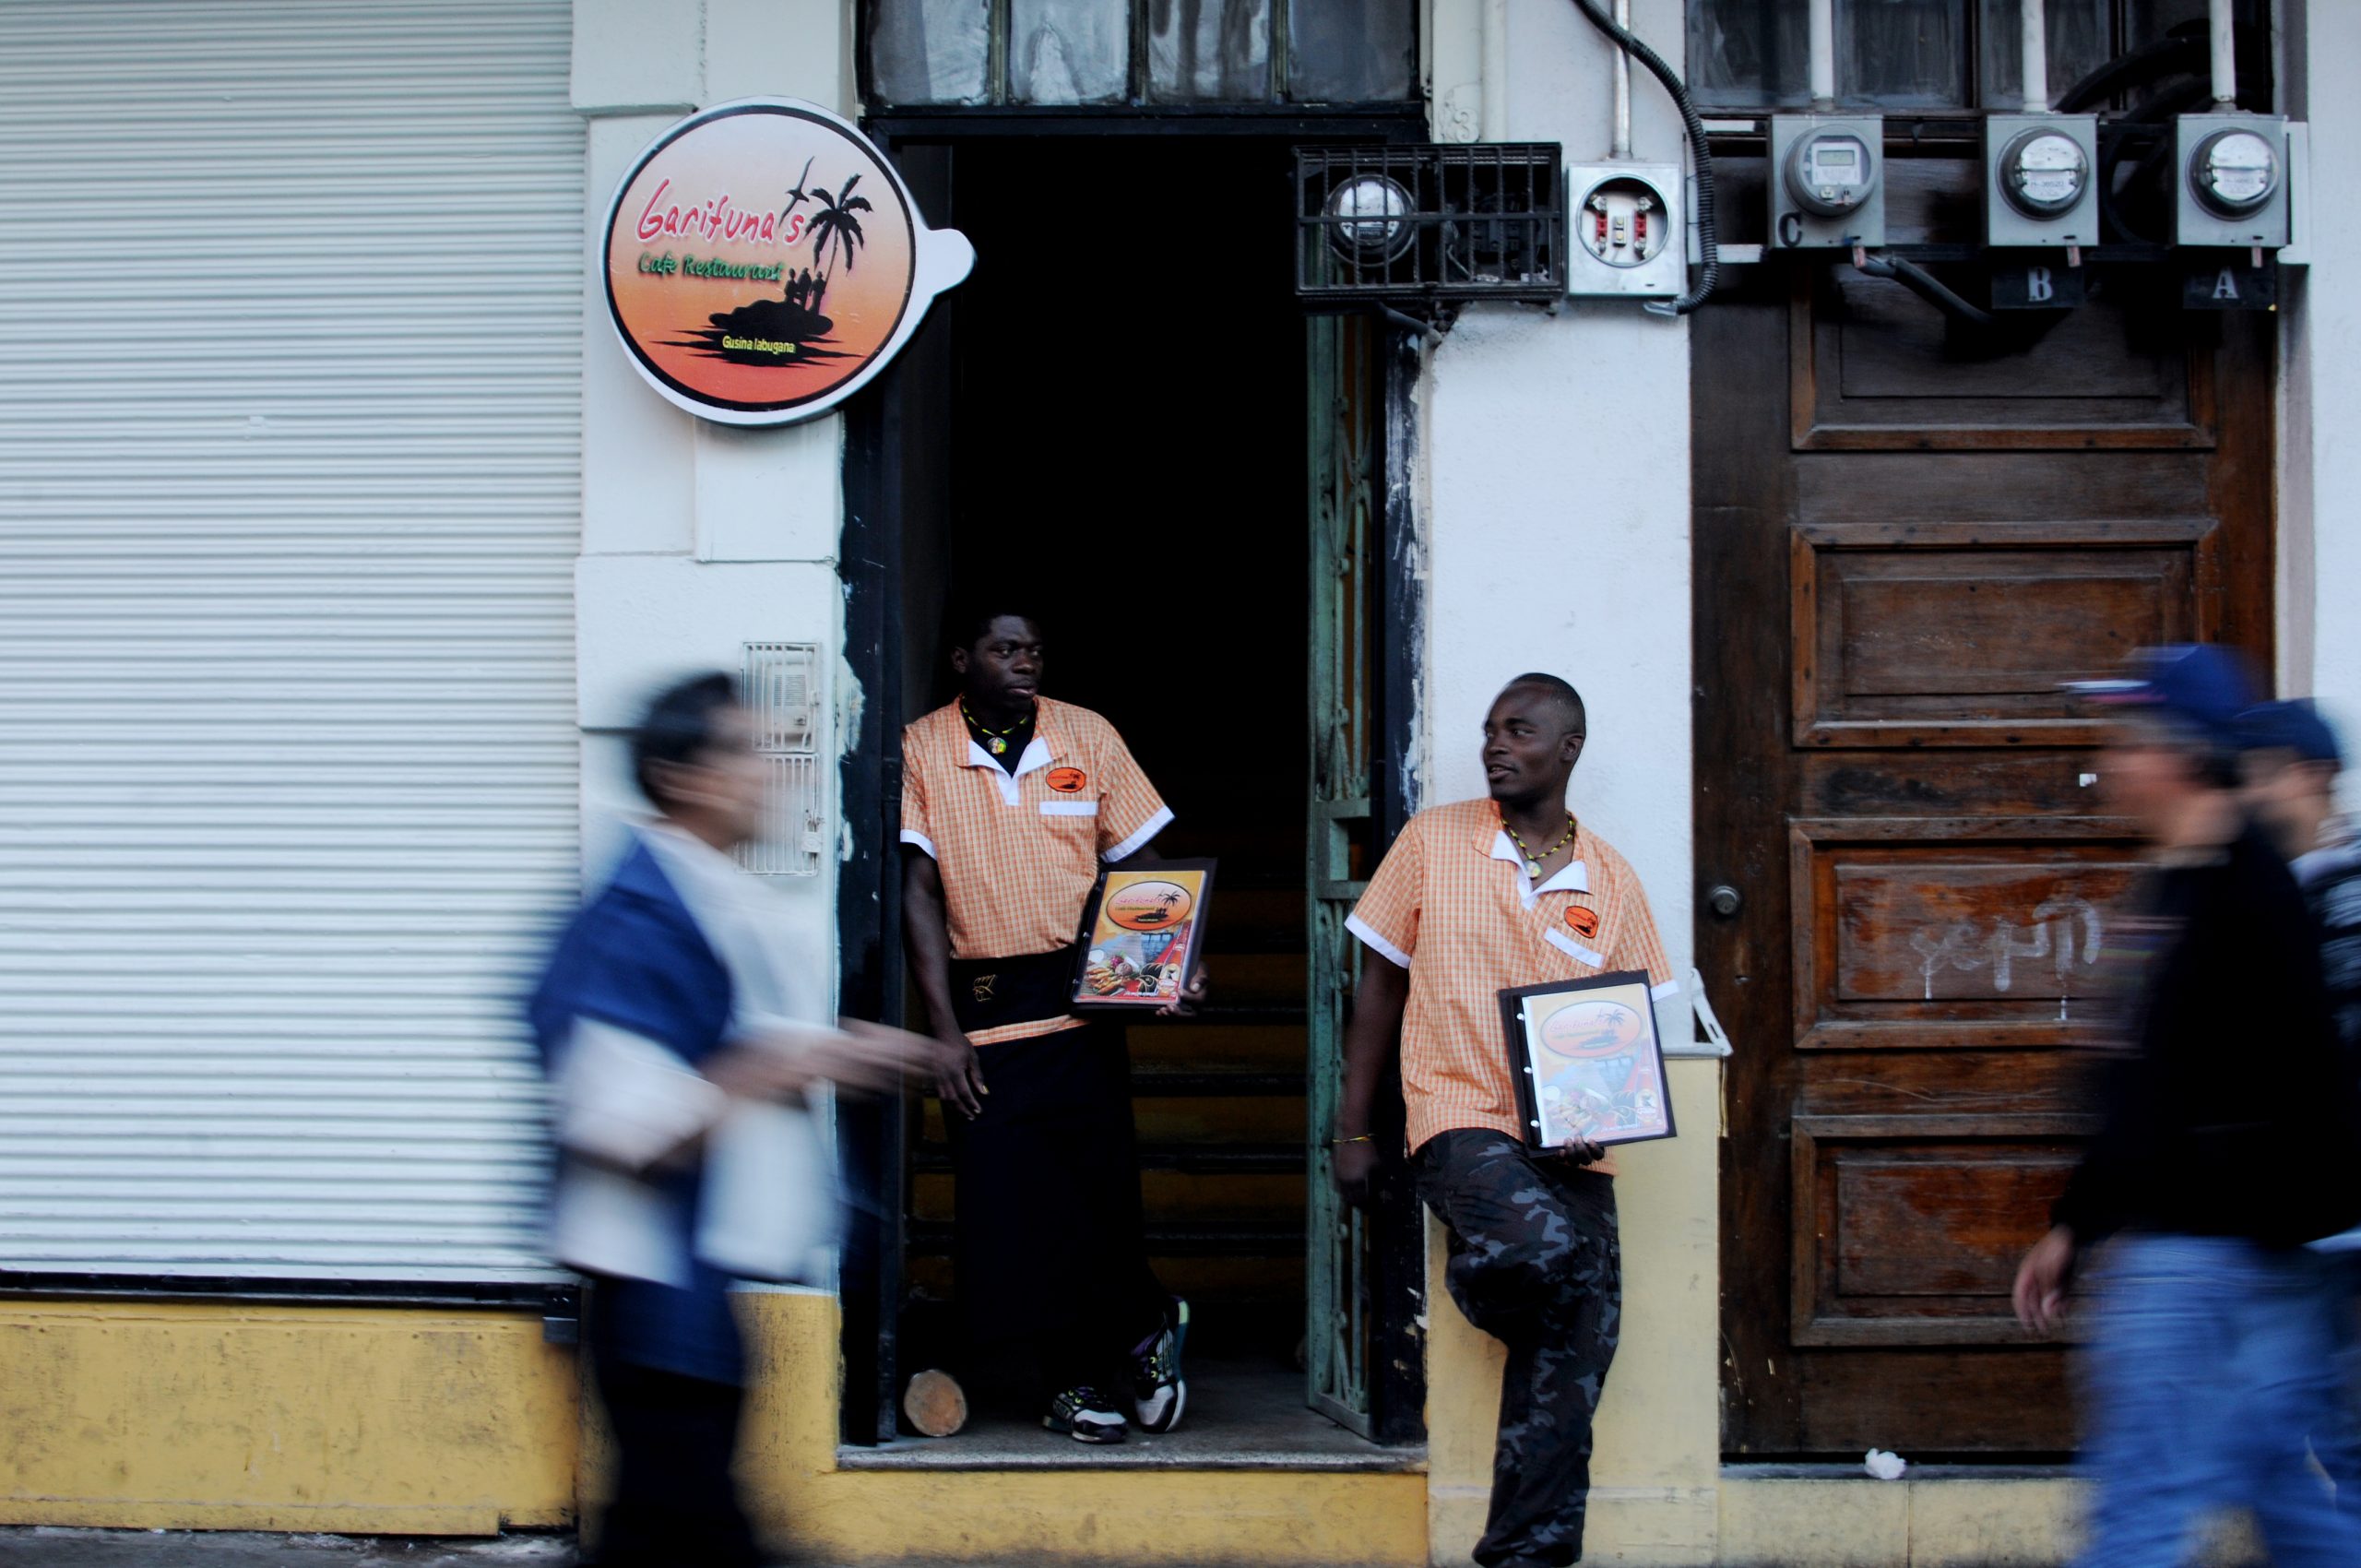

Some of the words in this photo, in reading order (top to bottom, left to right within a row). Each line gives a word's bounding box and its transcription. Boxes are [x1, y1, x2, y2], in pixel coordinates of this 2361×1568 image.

[1780, 212, 1803, 247] C
[683, 254, 784, 280] Restaurant
[2028, 266, 2053, 302] B
[2212, 265, 2239, 299] A
[722, 335, 753, 350] Gusina
